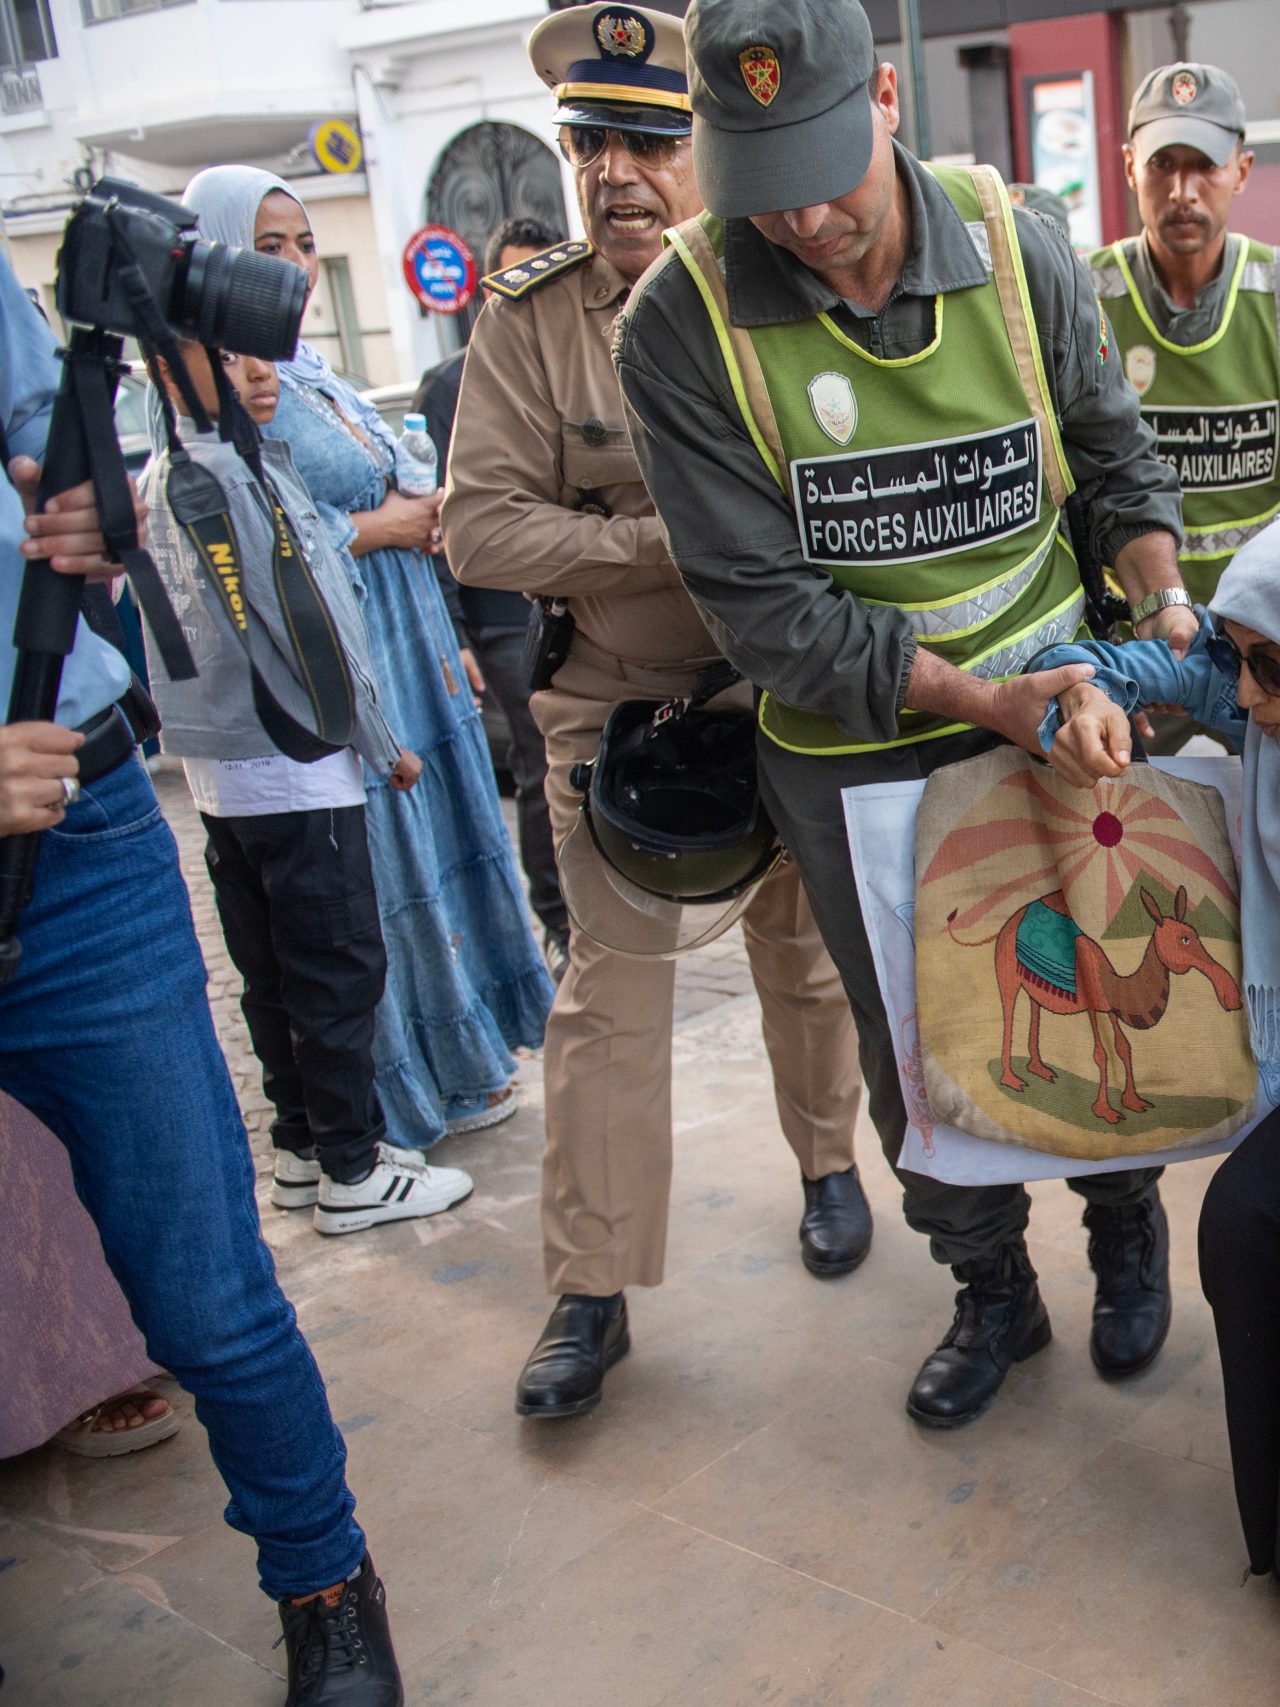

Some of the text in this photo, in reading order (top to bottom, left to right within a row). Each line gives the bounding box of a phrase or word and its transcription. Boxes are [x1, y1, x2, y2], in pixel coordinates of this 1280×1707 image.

[1153, 410, 1275, 449] القوات المسا
[1180, 447, 1273, 482] AUXILIAIRES
[804, 430, 1036, 503] القوات المساعدة
[809, 480, 1035, 553] FORCES AUXILIAIRES
[207, 543, 248, 630] Nikon
